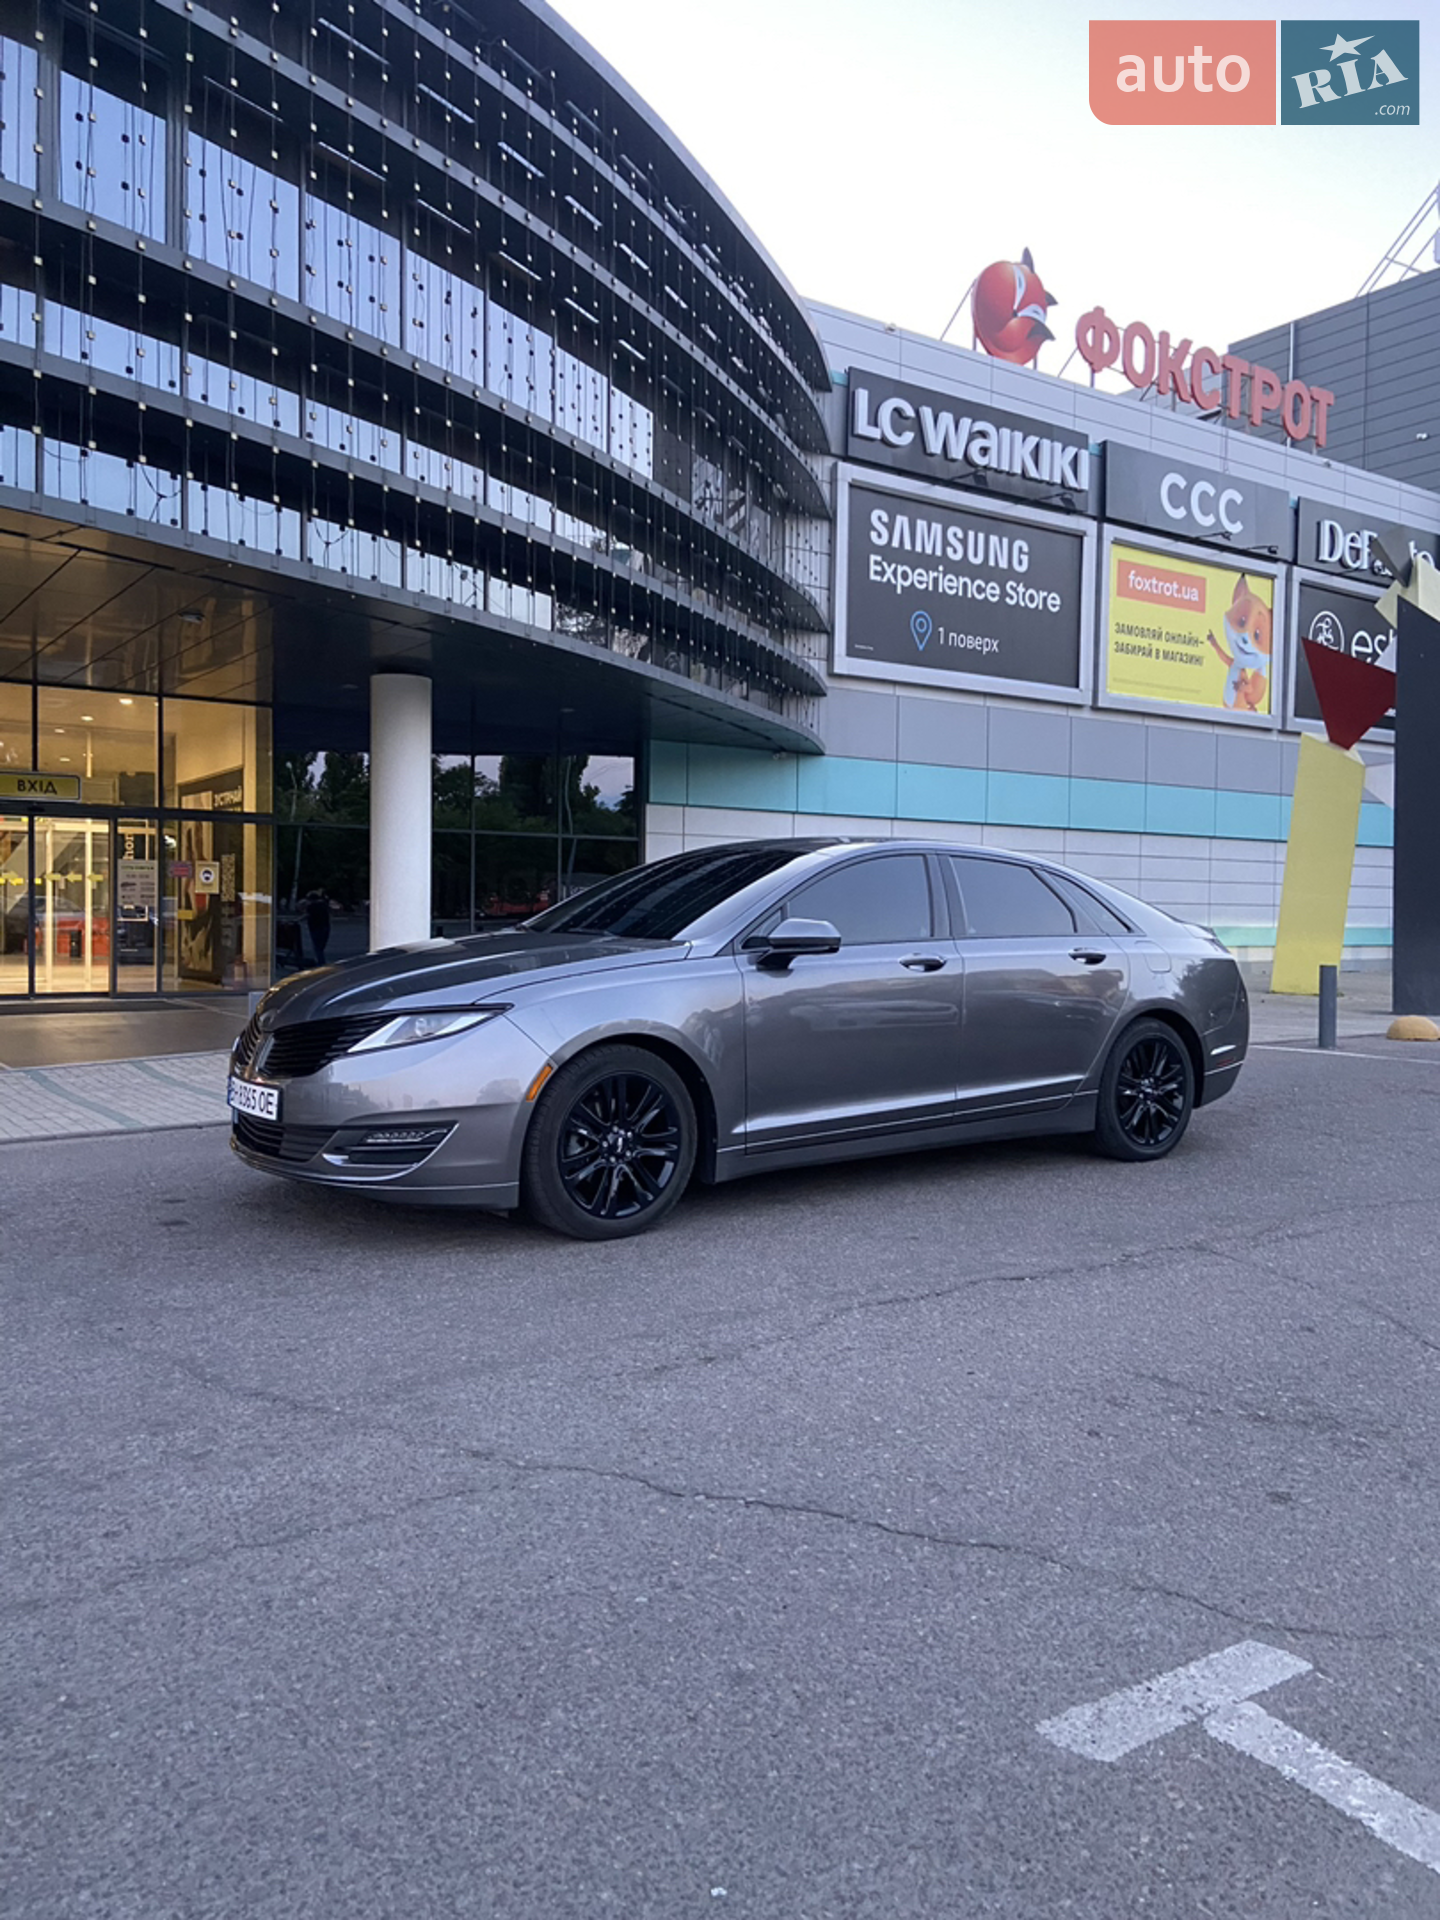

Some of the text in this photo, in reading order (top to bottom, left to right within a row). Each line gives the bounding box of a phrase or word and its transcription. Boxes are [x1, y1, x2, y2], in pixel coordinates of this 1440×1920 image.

[1075, 305, 1335, 448] ФОКСТРОТ
[853, 388, 914, 448] LC
[1160, 472, 1243, 534] CCC
[870, 509, 1030, 573] SAMSUNG
[869, 555, 1062, 613] Experience Store
[1128, 570, 1199, 602] foxtrot.ua
[937, 627, 1000, 655] 1 поверх
[1114, 622, 1163, 641] ЗАМОВЛЯЙ
[1114, 641, 1153, 659] ЗАБИРАЙ
[1155, 648, 1161, 660] В
[17, 779, 58, 796] ВХІД
[258, 1091, 275, 1115] OE
